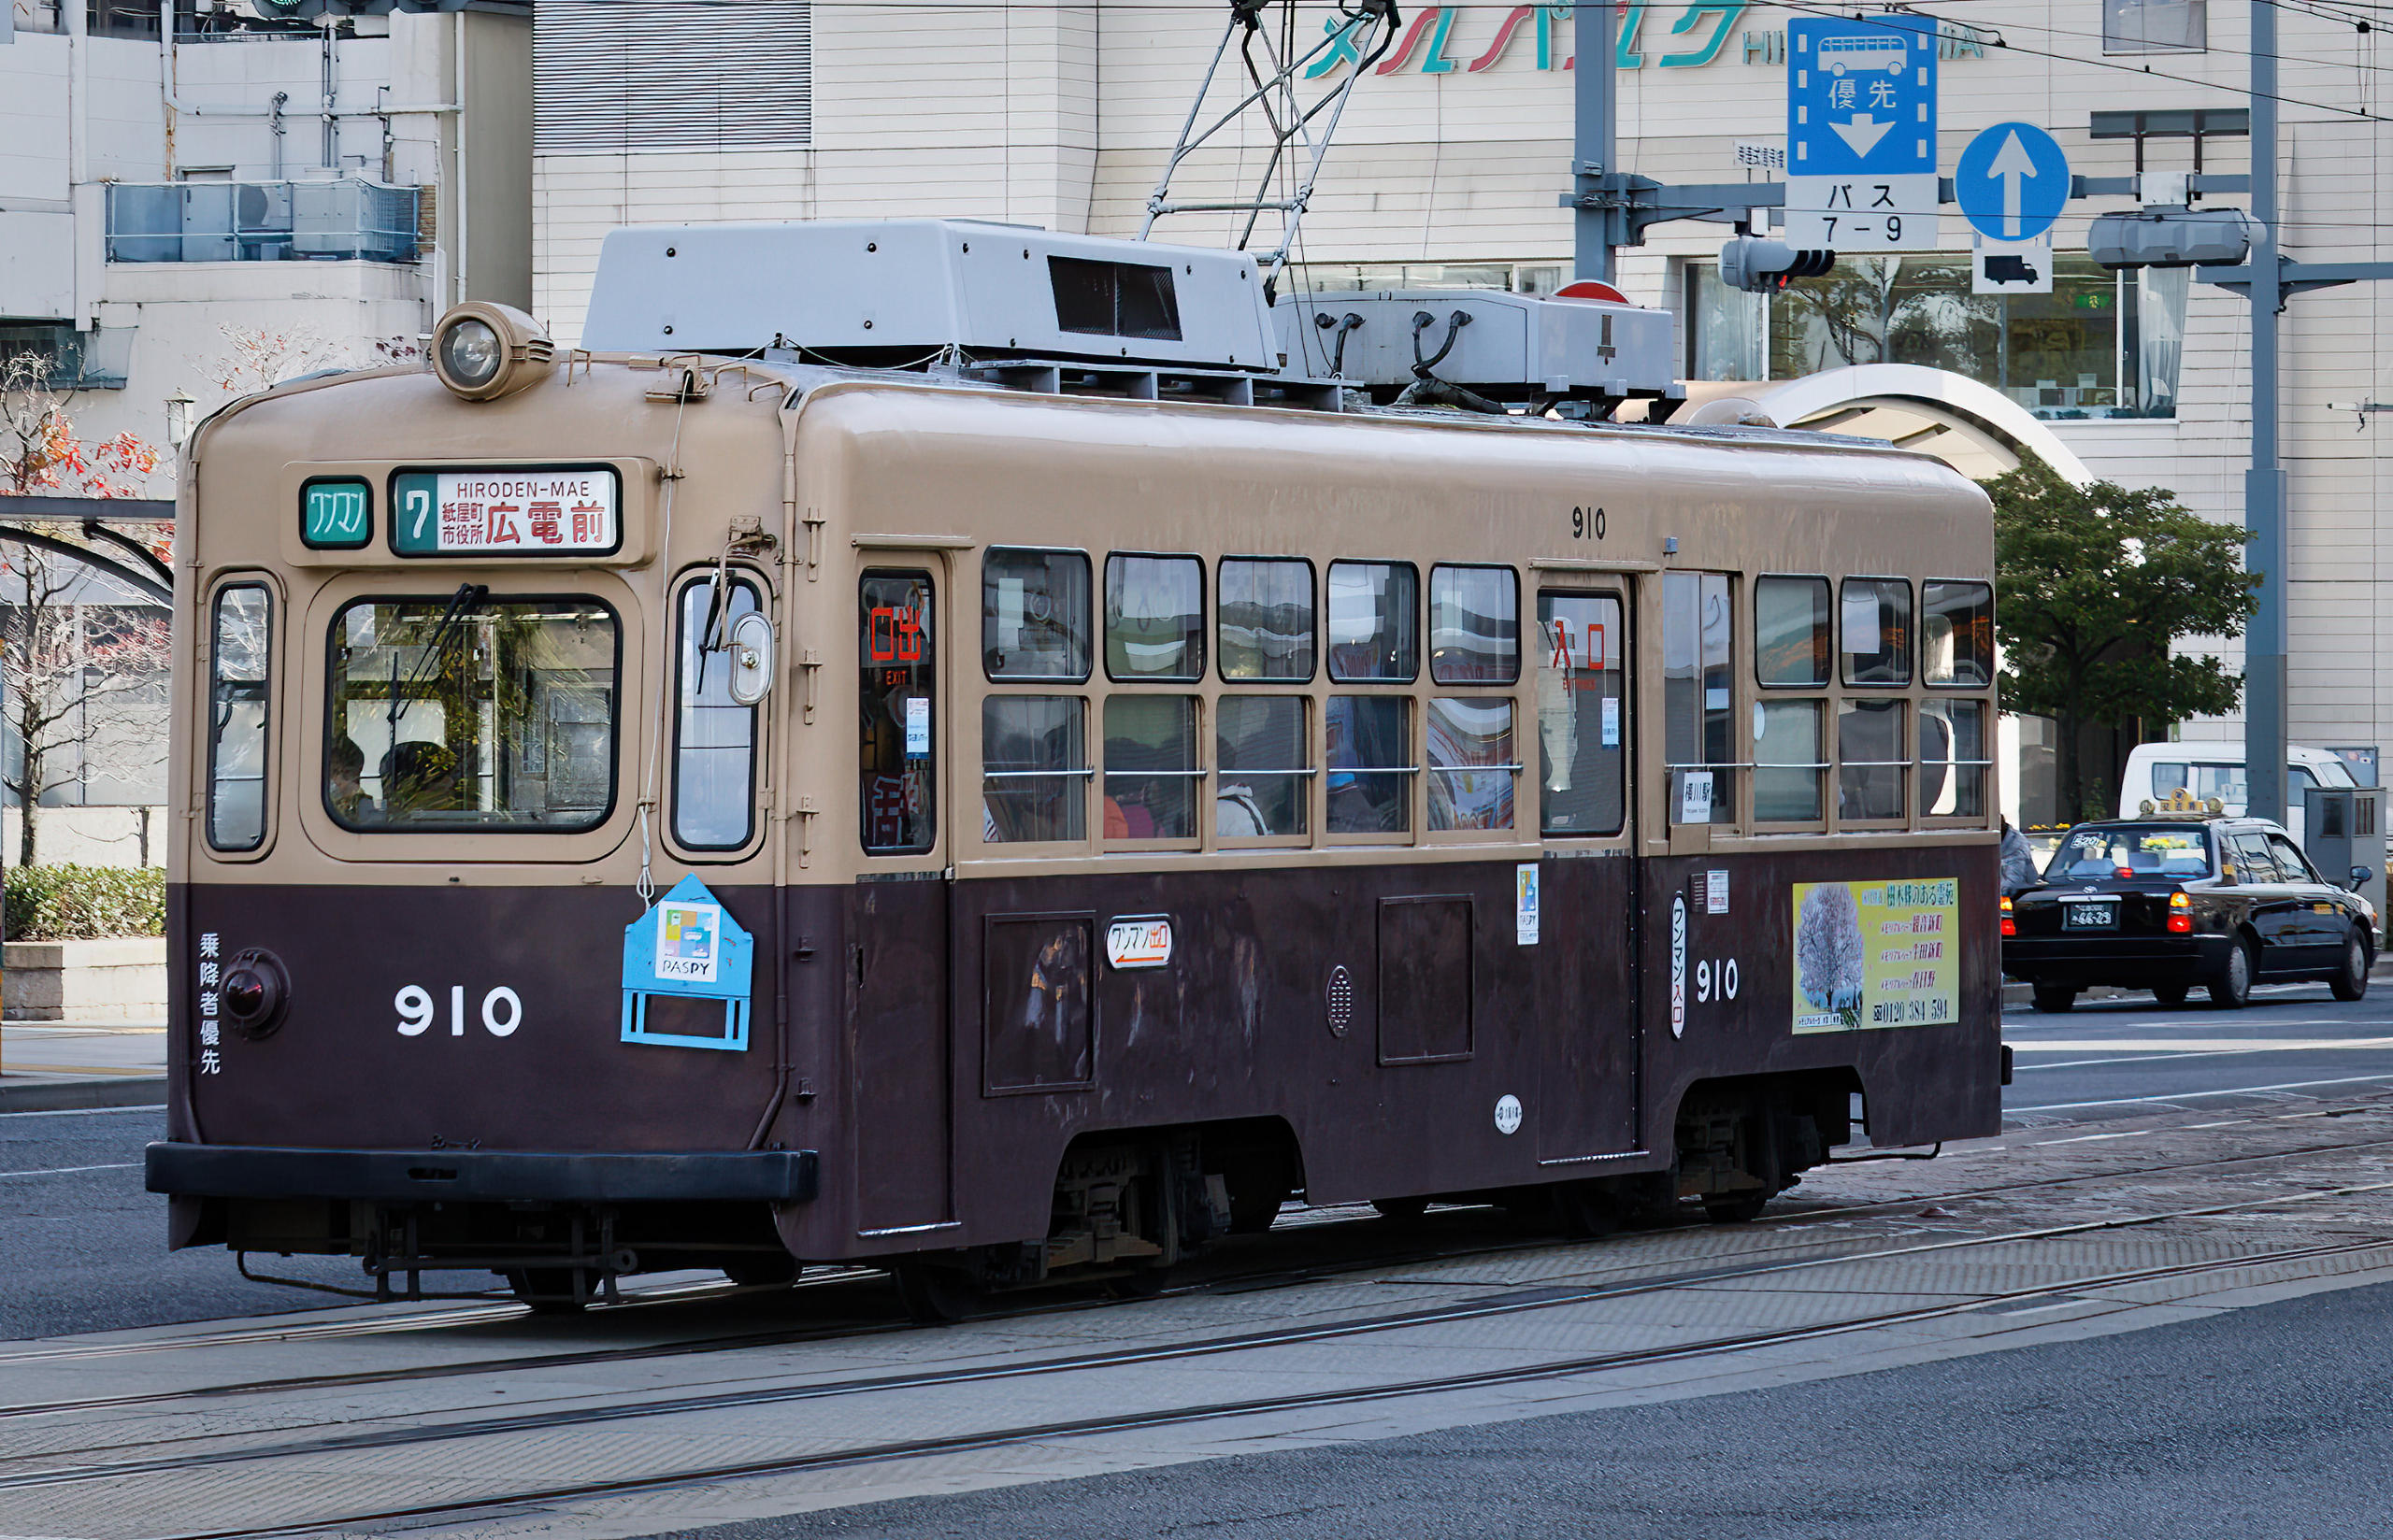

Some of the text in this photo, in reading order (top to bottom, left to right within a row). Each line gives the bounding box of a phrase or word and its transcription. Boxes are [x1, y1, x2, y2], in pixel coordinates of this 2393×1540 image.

[1828, 79, 1897, 109] 優先
[1827, 184, 1895, 209] バス
[457, 481, 590, 498] HIRODEN-MAE
[406, 490, 430, 539] 7
[442, 502, 484, 522] 紙屋町
[485, 500, 606, 545] 広電前
[1572, 506, 1606, 540] 910
[442, 524, 483, 545] 市役所
[885, 670, 907, 686] EXIT
[663, 960, 709, 975] PASPY
[1672, 907, 1684, 1024] ワンマン入口
[1697, 958, 1739, 1003] 910
[199, 933, 221, 1075] 乗降者優先
[394, 984, 523, 1037] 910
[1884, 1002, 1904, 1023] 0120
